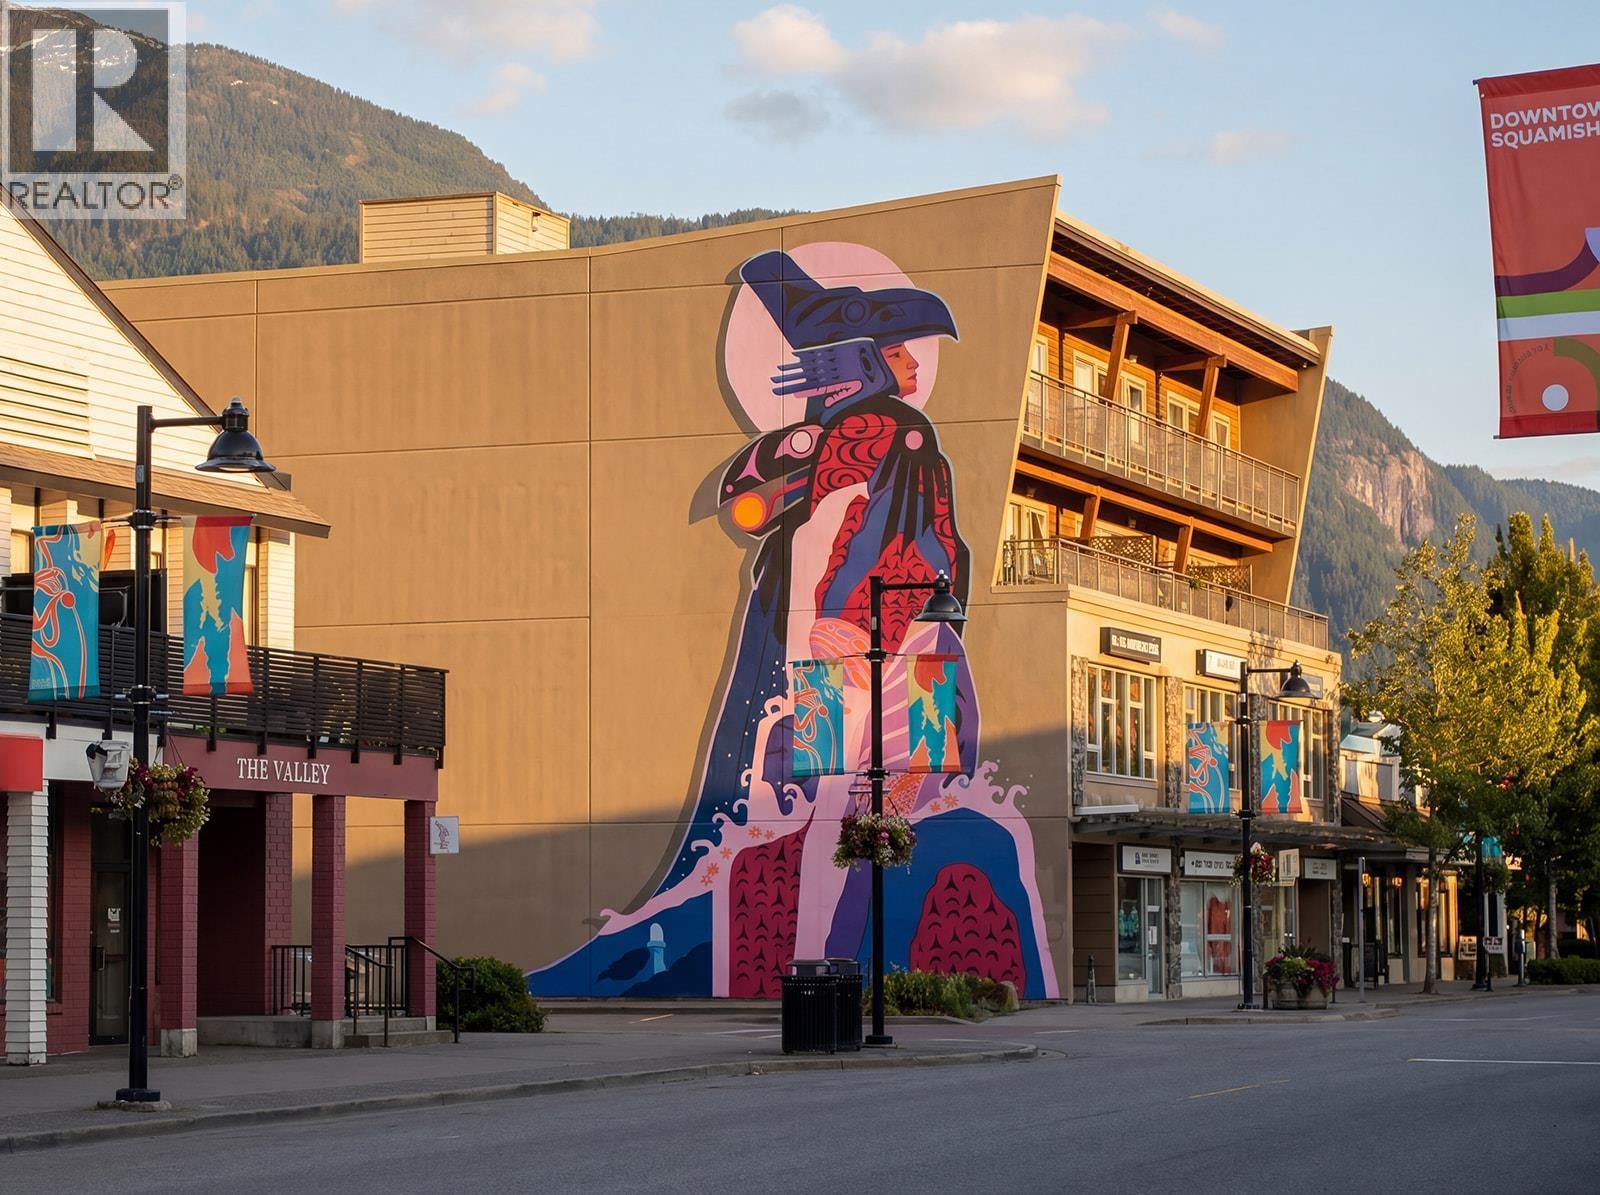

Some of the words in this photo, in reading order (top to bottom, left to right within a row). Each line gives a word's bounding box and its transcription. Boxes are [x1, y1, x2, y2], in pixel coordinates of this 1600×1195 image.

[1491, 120, 1600, 149] SQUAMISH
[237, 758, 268, 780] THE
[273, 760, 330, 785] VALLEY
